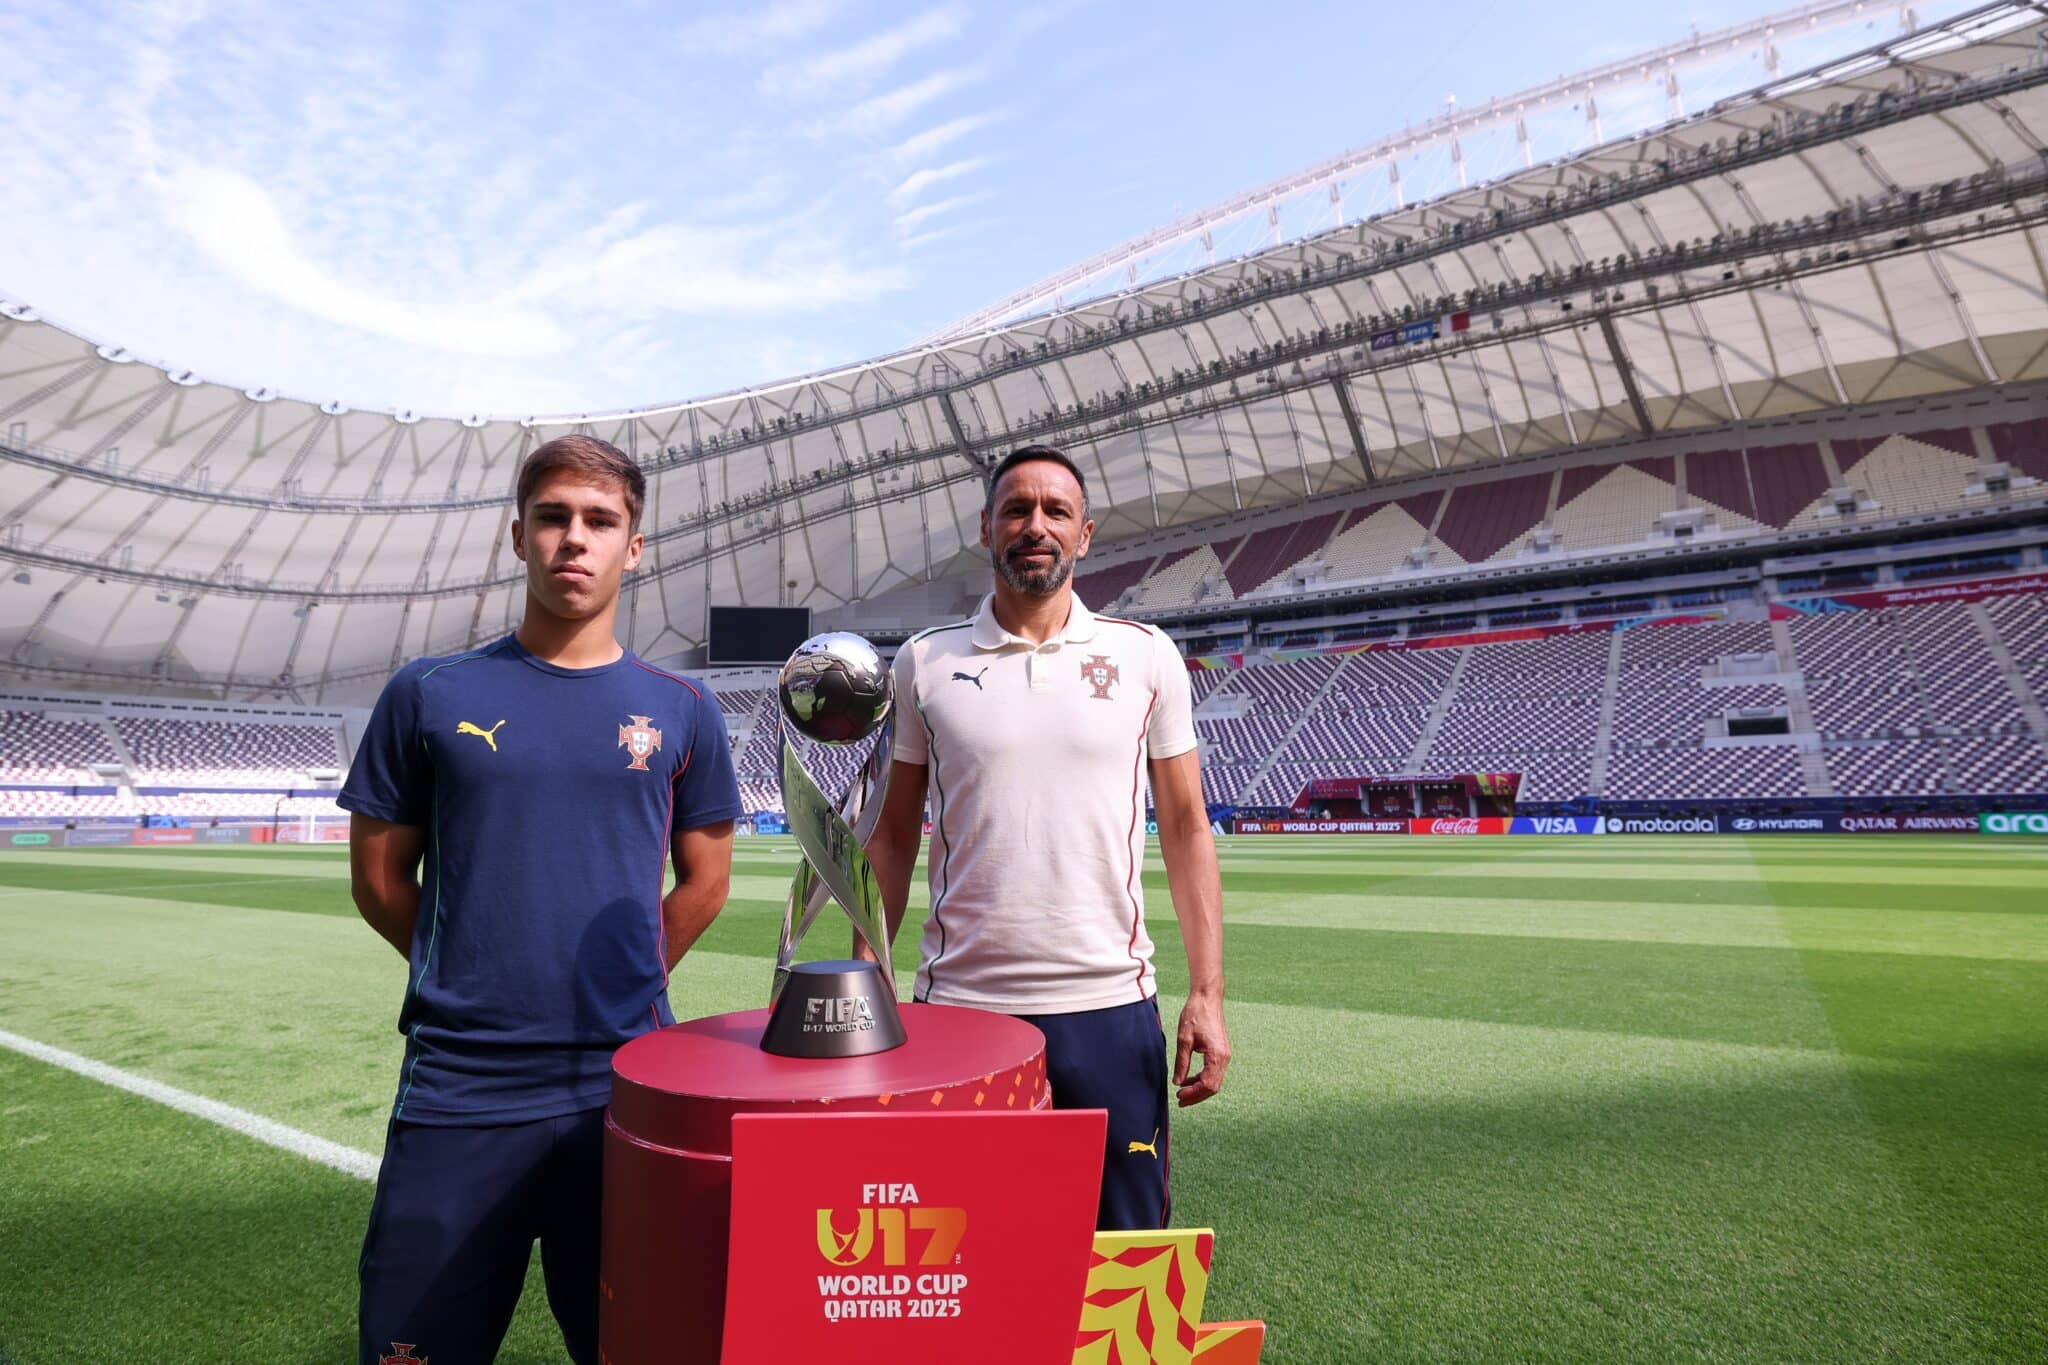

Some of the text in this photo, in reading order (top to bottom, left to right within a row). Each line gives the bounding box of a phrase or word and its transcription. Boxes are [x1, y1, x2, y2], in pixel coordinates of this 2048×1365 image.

[1241, 823, 1262, 832] FIFA
[1283, 823, 1317, 832] WORLD
[1318, 823, 1338, 832] CUP
[1340, 822, 1375, 833] QATAR
[1376, 822, 1400, 831] 2025
[1530, 818, 1577, 833] VISA
[1625, 817, 1714, 832] motorola
[1759, 818, 1823, 829] HYUNDAI
[1840, 817, 1979, 831] QATAR AIRWAYS
[804, 997, 873, 1022] FIFA
[803, 1023, 823, 1033] U-17
[825, 1023, 857, 1033] WORLD
[863, 1183, 920, 1204] FIFA
[816, 1207, 968, 1267] U17
[816, 1274, 968, 1296] WORLD CUP
[824, 1299, 961, 1322] QATAR 2025
